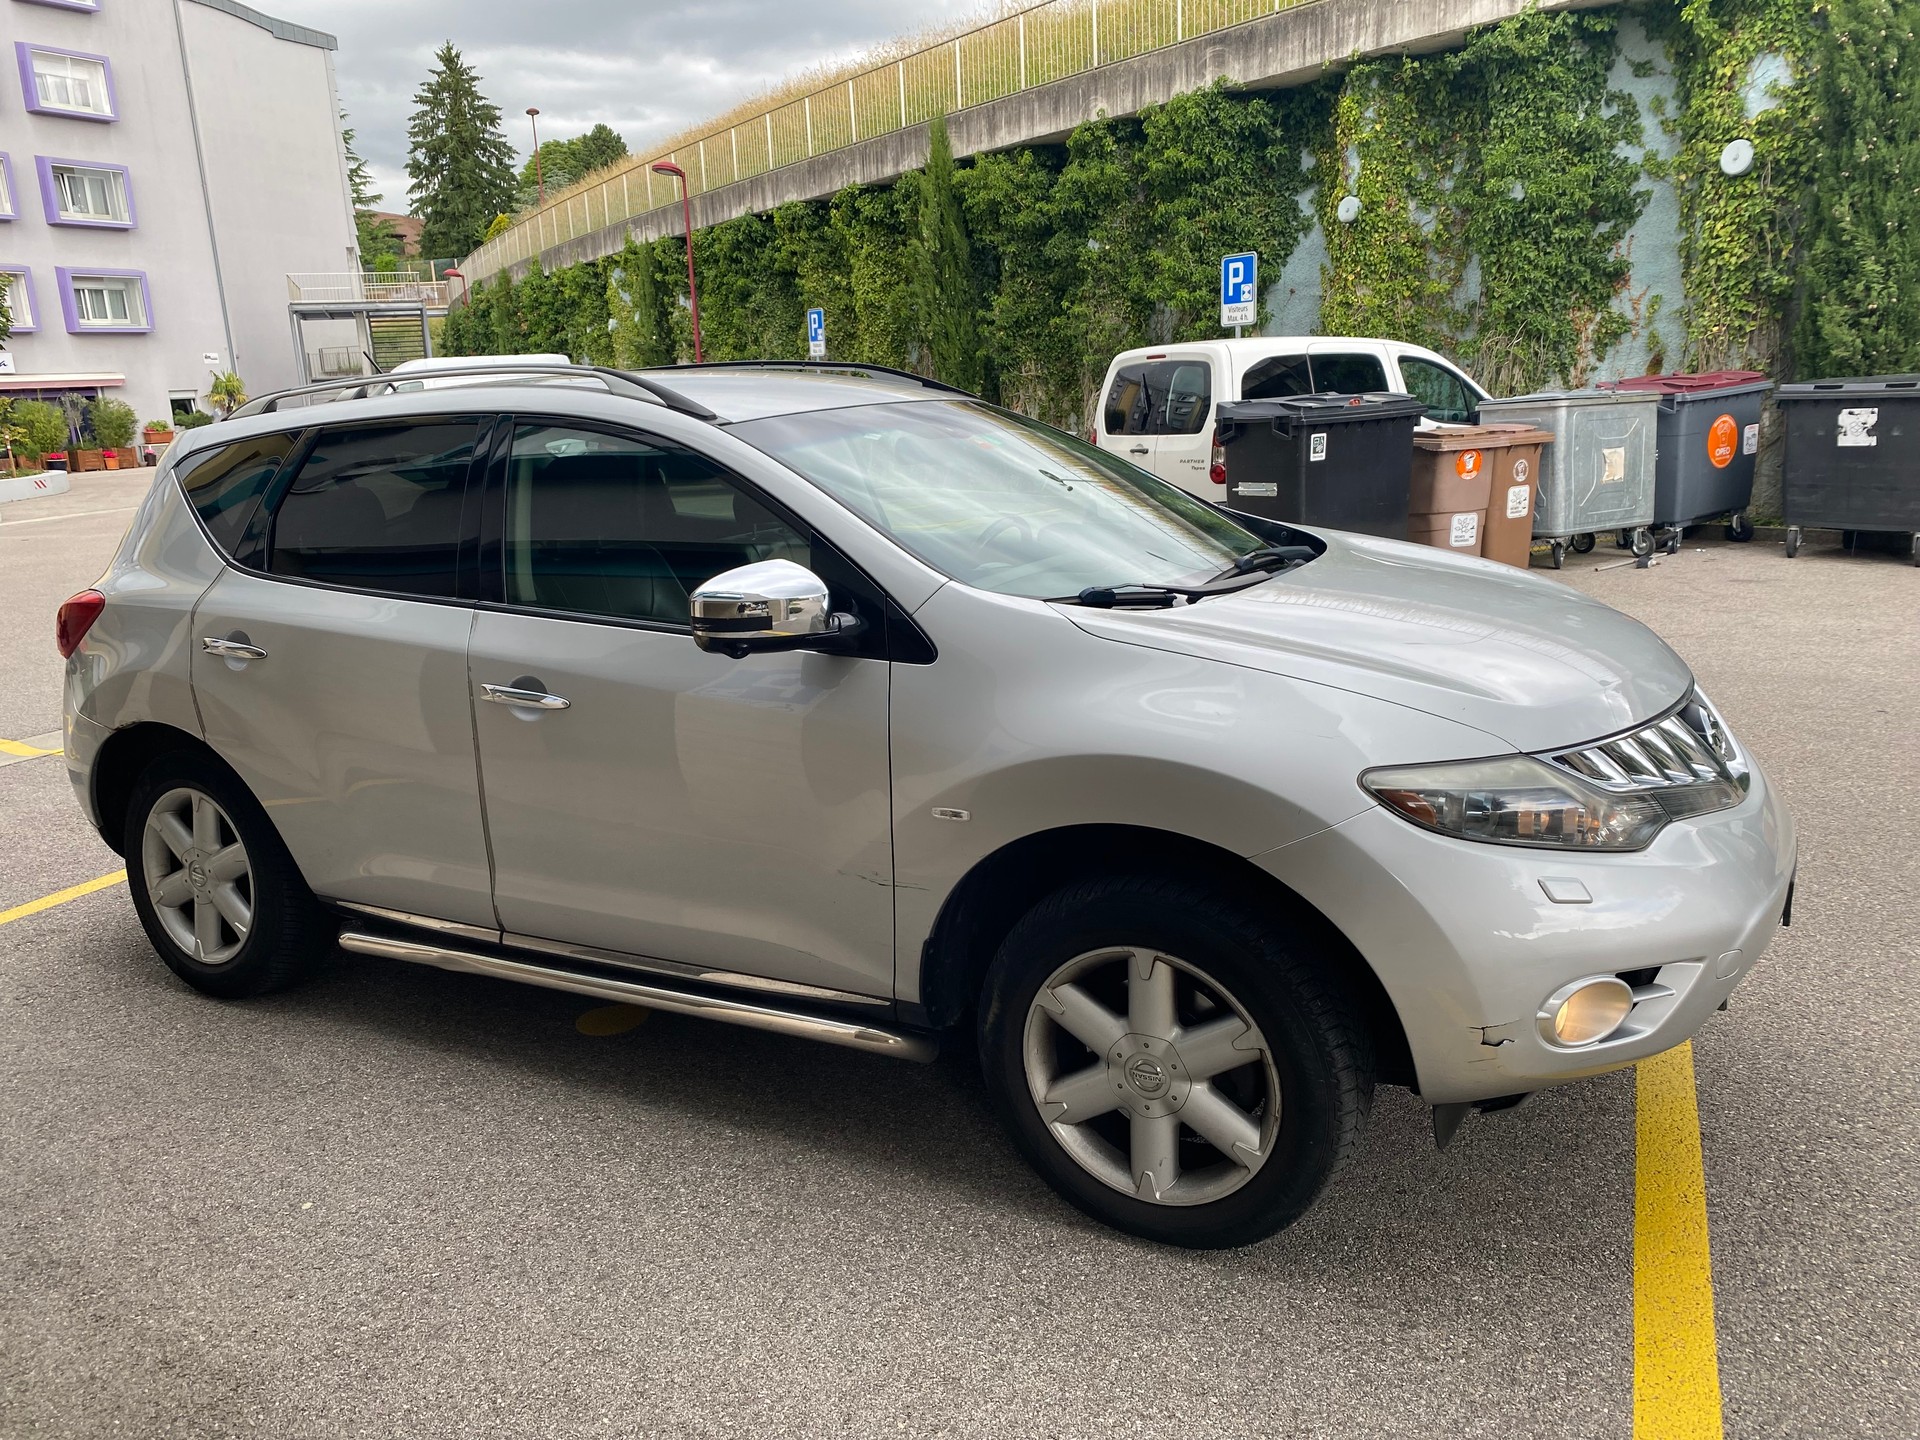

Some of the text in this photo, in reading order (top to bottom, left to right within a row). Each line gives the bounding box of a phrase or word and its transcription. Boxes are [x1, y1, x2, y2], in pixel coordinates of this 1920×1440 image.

[1229, 261, 1244, 297] P
[811, 313, 818, 337] P
[1132, 1071, 1162, 1082] NISSAN
